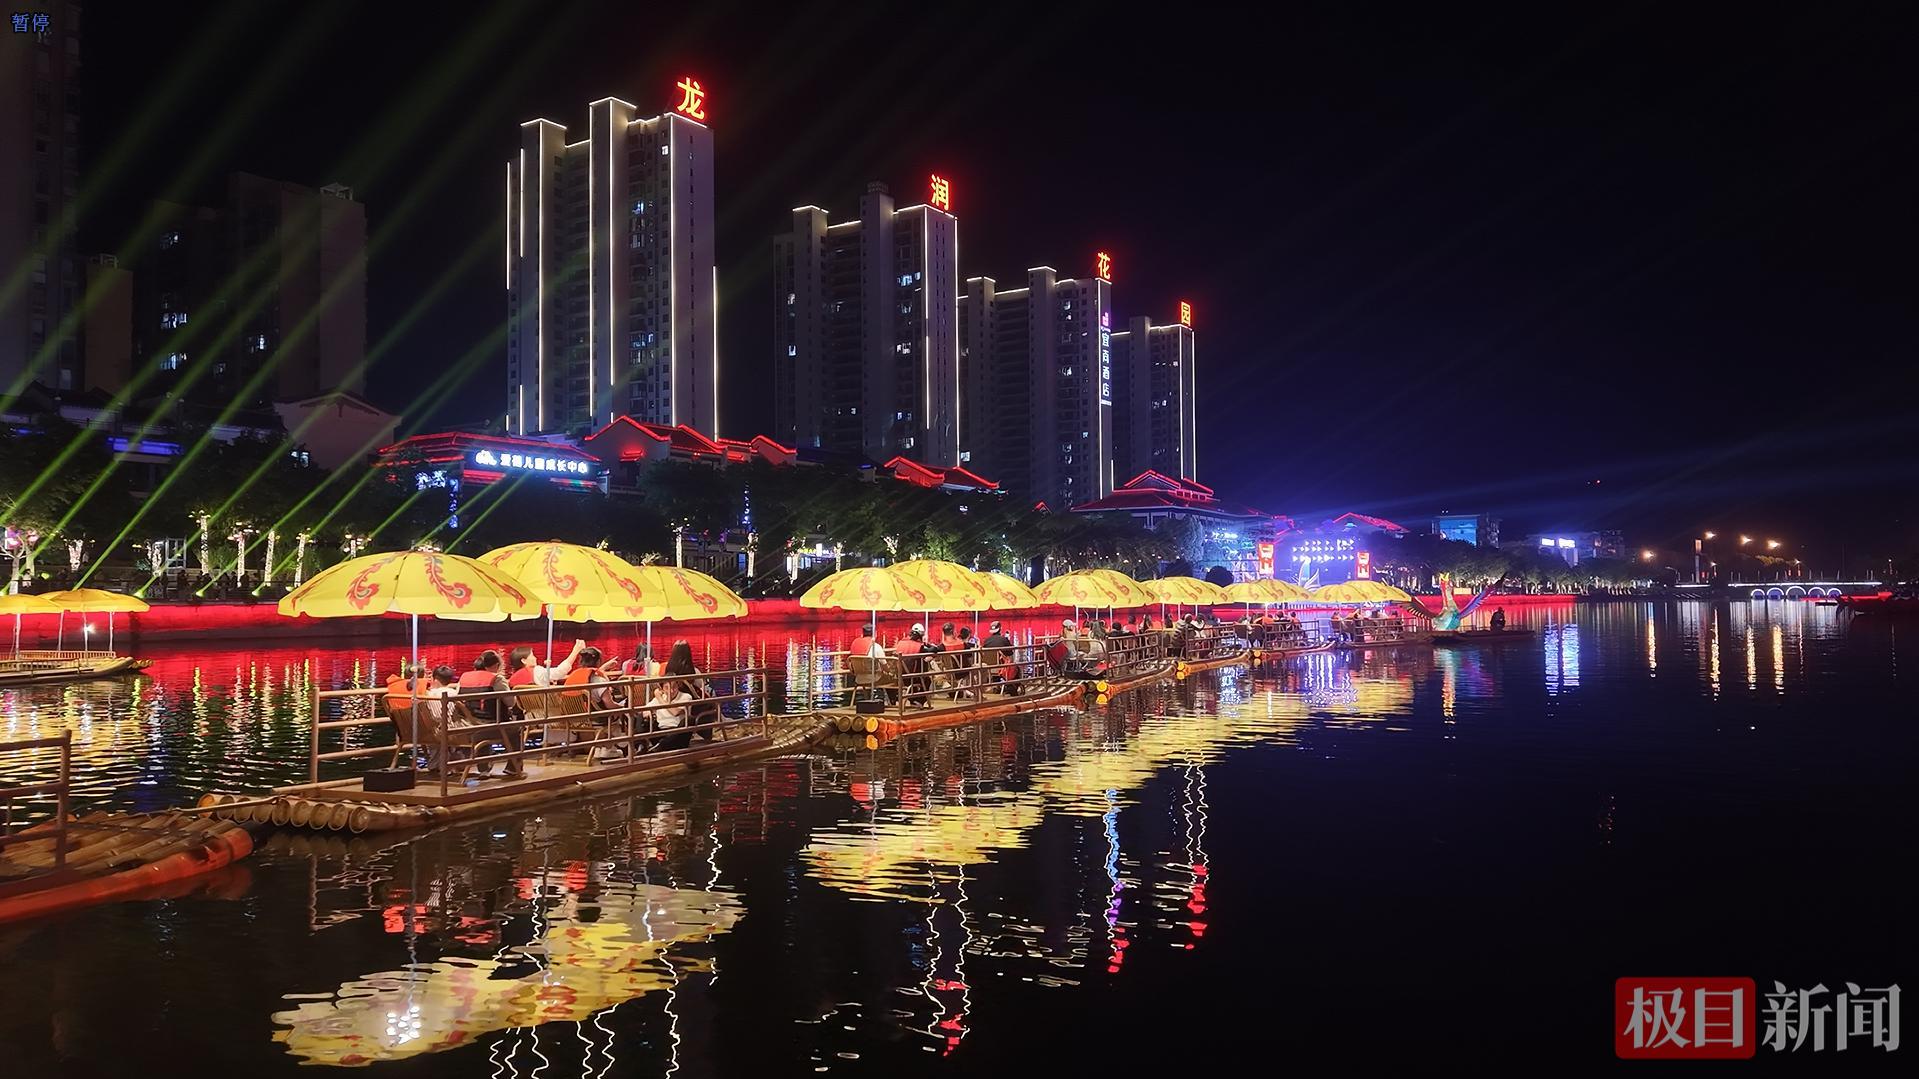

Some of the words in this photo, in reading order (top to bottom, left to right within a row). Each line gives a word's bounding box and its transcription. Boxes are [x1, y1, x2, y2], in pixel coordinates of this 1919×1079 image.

[677, 77, 705, 119] 龙
[931, 174, 949, 211] 润
[1098, 252, 1111, 280] 花
[1181, 301, 1191, 327] 园
